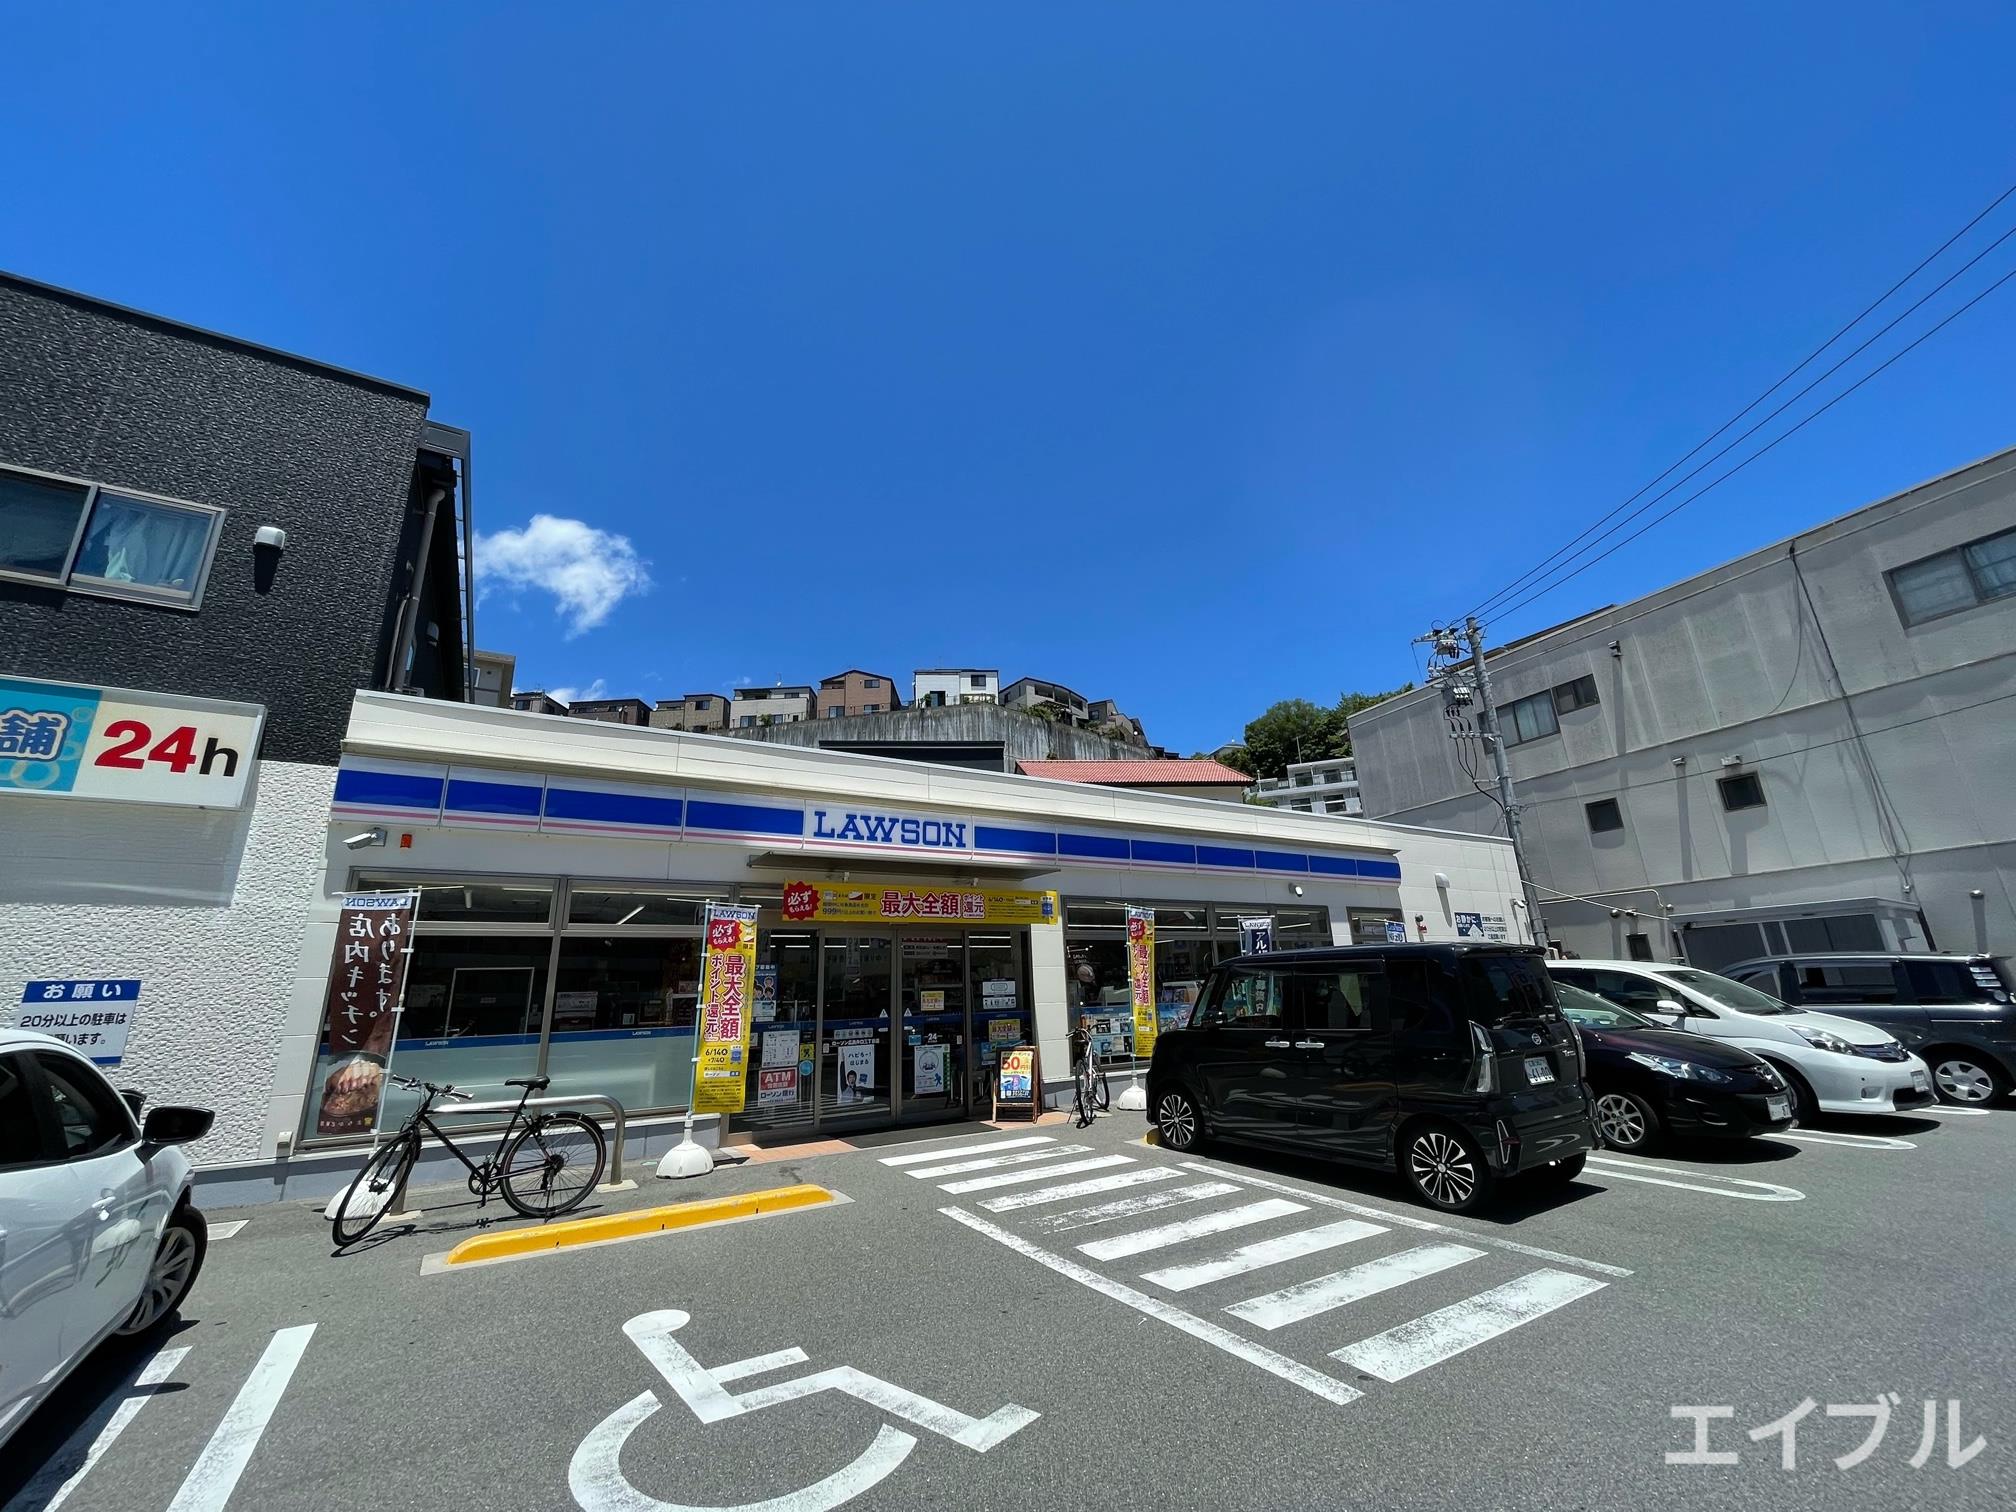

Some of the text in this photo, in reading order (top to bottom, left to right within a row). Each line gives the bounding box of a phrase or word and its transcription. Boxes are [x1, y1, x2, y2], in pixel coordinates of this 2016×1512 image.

[95, 720, 239, 776] 24h
[814, 811, 966, 848] LAWSON
[788, 890, 812, 905] 必ず
[881, 890, 960, 916] 最大全額
[713, 908, 755, 920] LAWSON
[963, 901, 984, 914] 還元
[712, 922, 736, 937] 必ず
[1255, 931, 1267, 953] アル
[43, 983, 122, 998] お願い
[705, 955, 723, 1034] ポイント還元
[720, 955, 746, 1039] 最大全額
[20, 1013, 127, 1028] 20分以上の駐車は
[764, 1071, 792, 1083] ATM
